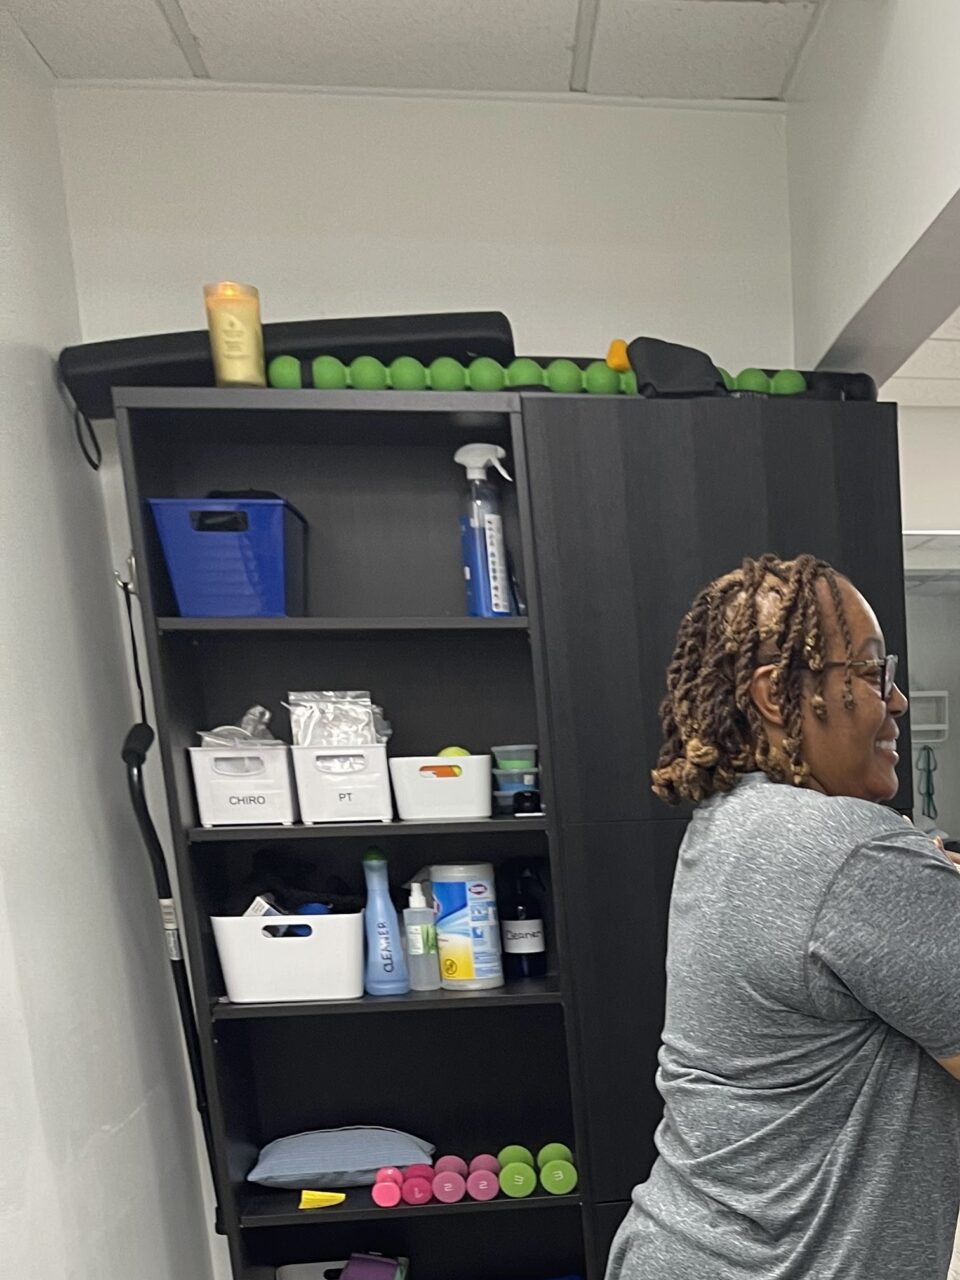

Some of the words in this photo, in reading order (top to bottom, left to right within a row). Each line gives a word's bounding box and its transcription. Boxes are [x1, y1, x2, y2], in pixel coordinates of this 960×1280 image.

[228, 795, 266, 805] CHIRO
[338, 792, 353, 802] PT
[377, 921, 395, 973] CLEANER
[513, 1175, 524, 1185] 3
[553, 1170, 564, 1181] 3
[444, 1183, 454, 1192] 2
[479, 1181, 489, 1190] 2
